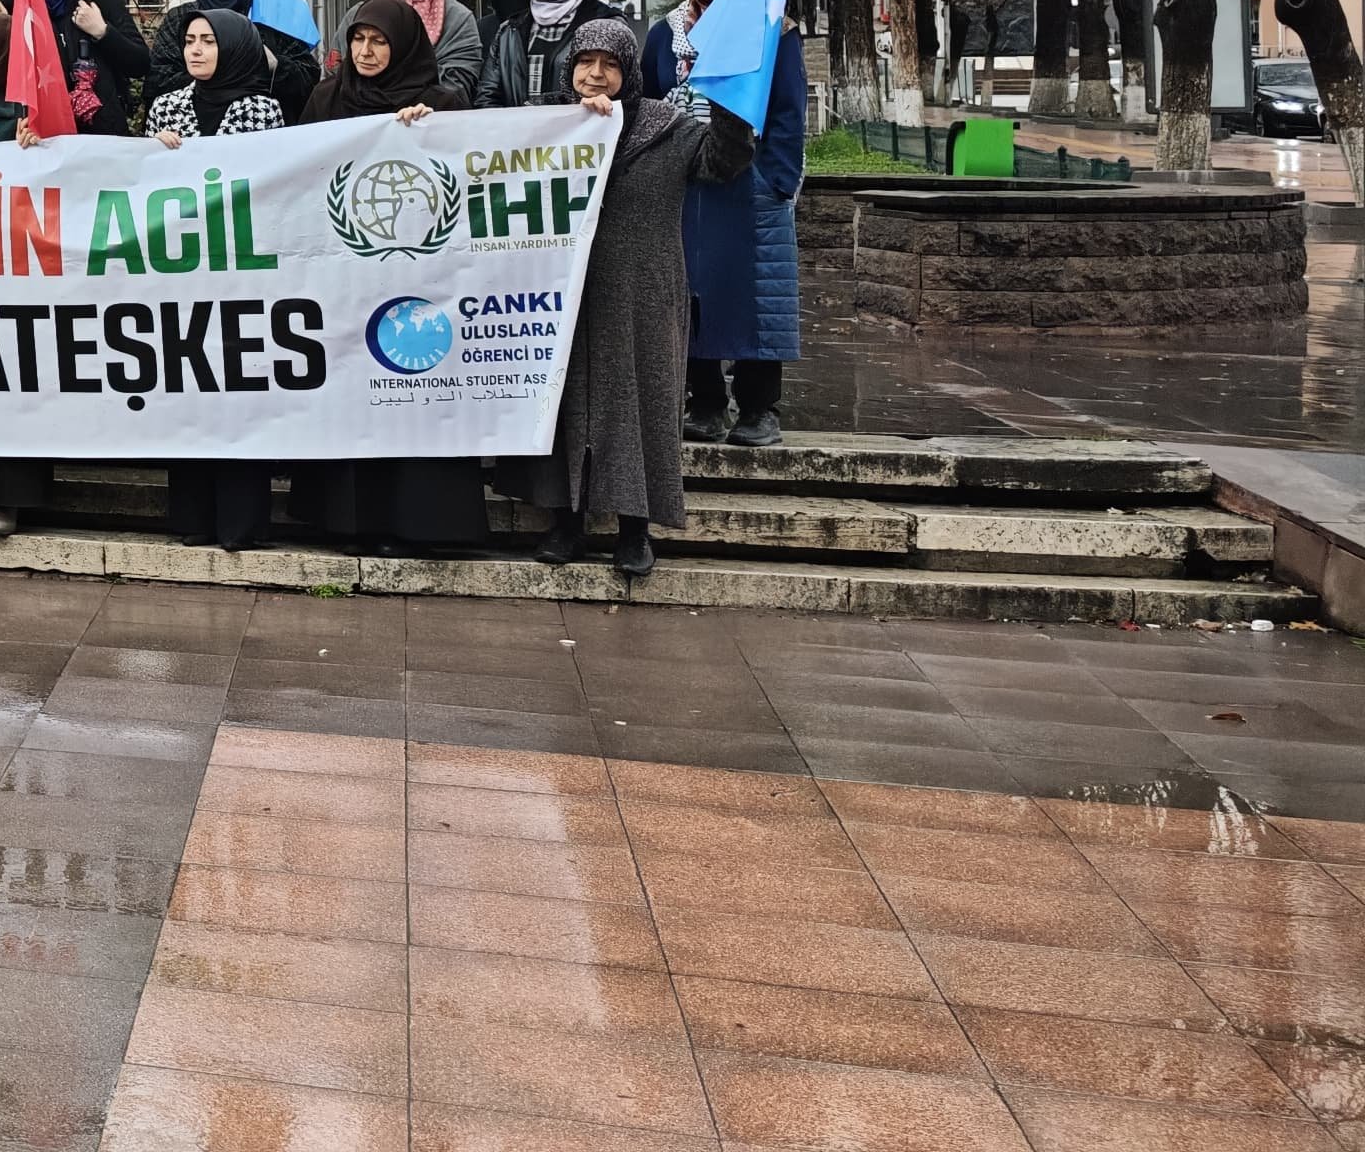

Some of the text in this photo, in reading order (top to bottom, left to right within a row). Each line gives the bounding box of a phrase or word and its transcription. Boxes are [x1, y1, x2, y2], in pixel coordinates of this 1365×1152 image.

[465, 142, 606, 184] ÇANKIRI
[86, 167, 279, 277] ACİL
[513, 238, 559, 250] YARDIM
[460, 322, 560, 341] ULUSLARA
[461, 344, 530, 364] ÖĞRENCİ
[369, 377, 464, 390] INTERNATIONAL
[466, 374, 520, 387] STUDENT
